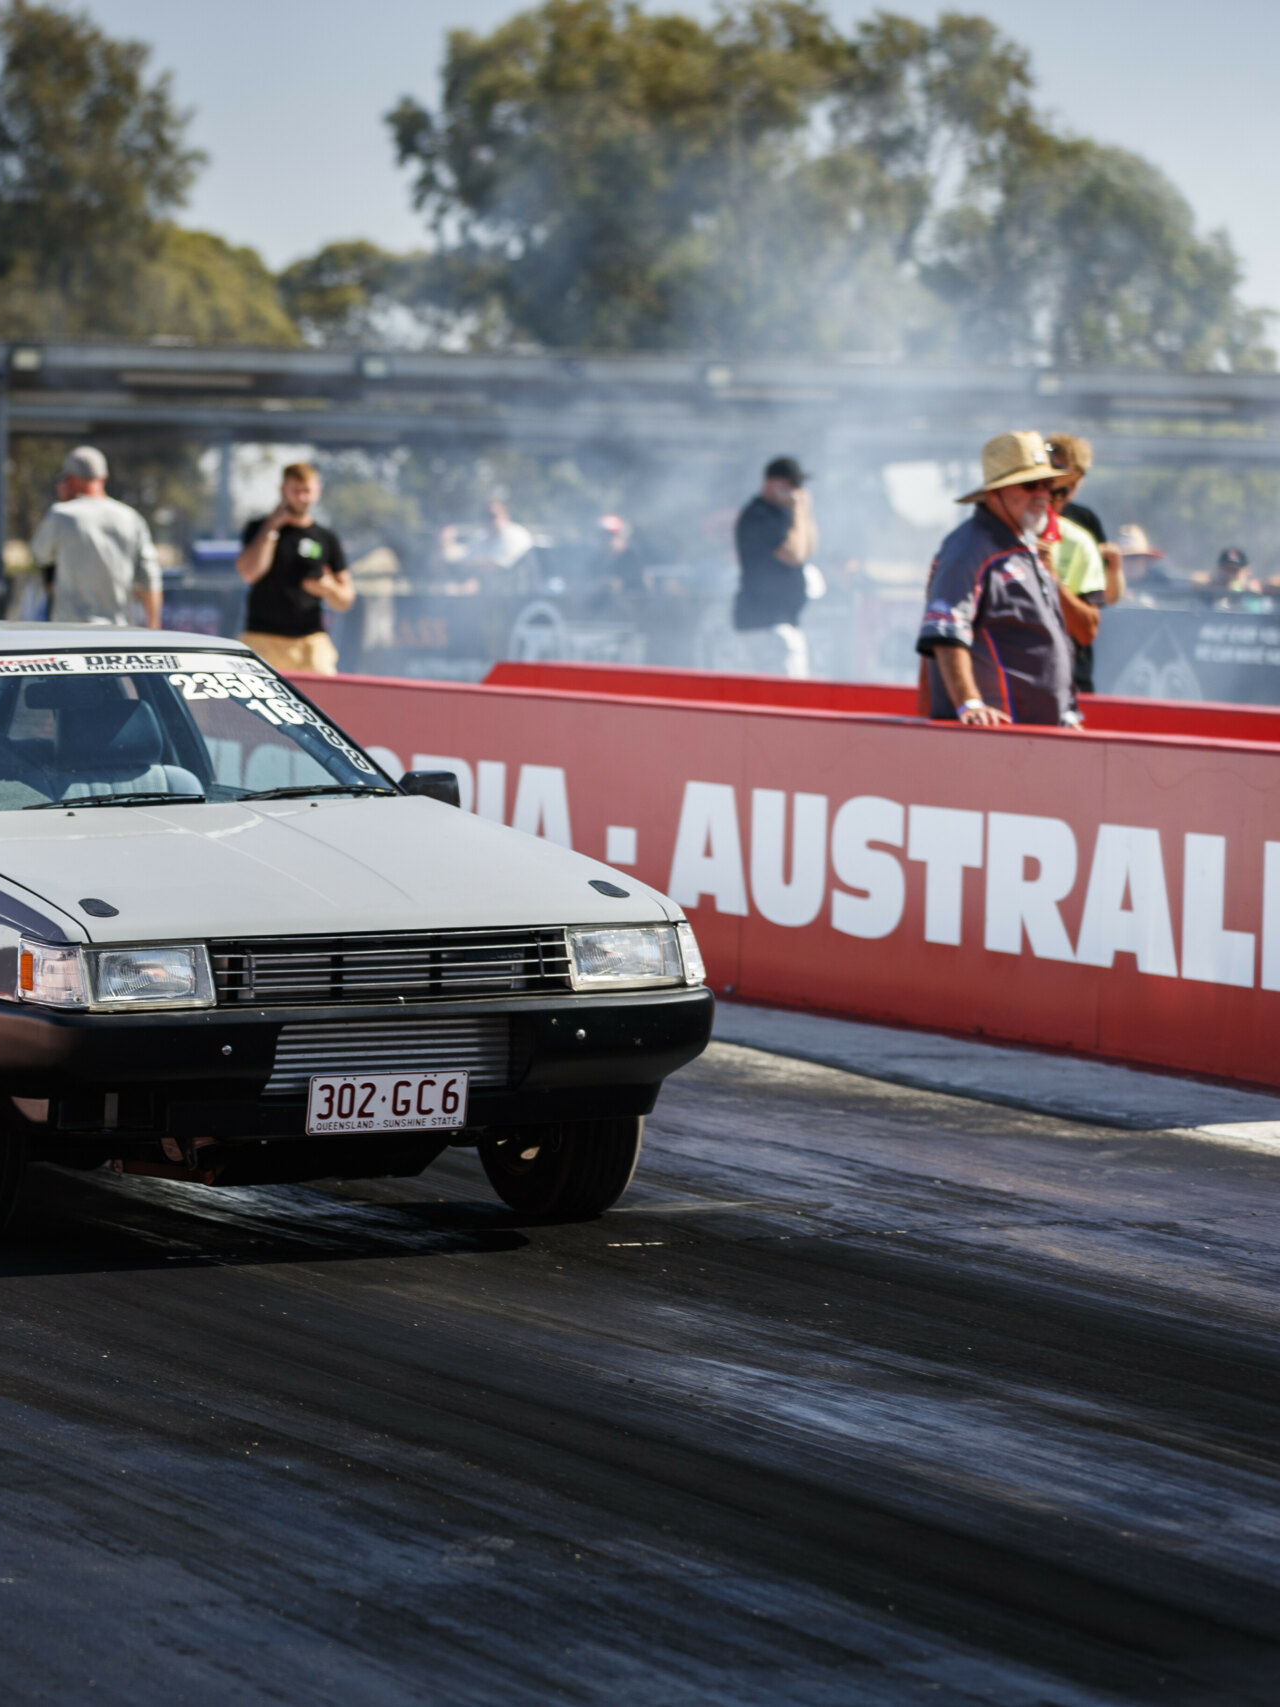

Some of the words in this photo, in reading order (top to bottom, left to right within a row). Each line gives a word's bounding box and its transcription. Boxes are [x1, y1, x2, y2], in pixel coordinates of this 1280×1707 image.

[83, 655, 165, 666] DRAG
[169, 673, 276, 700] 235B
[246, 698, 305, 725] 16
[316, 1120, 374, 1131] QUEENSLAND
[382, 1118, 427, 1129] SUNSHINE
[431, 1116, 458, 1126] STATE
